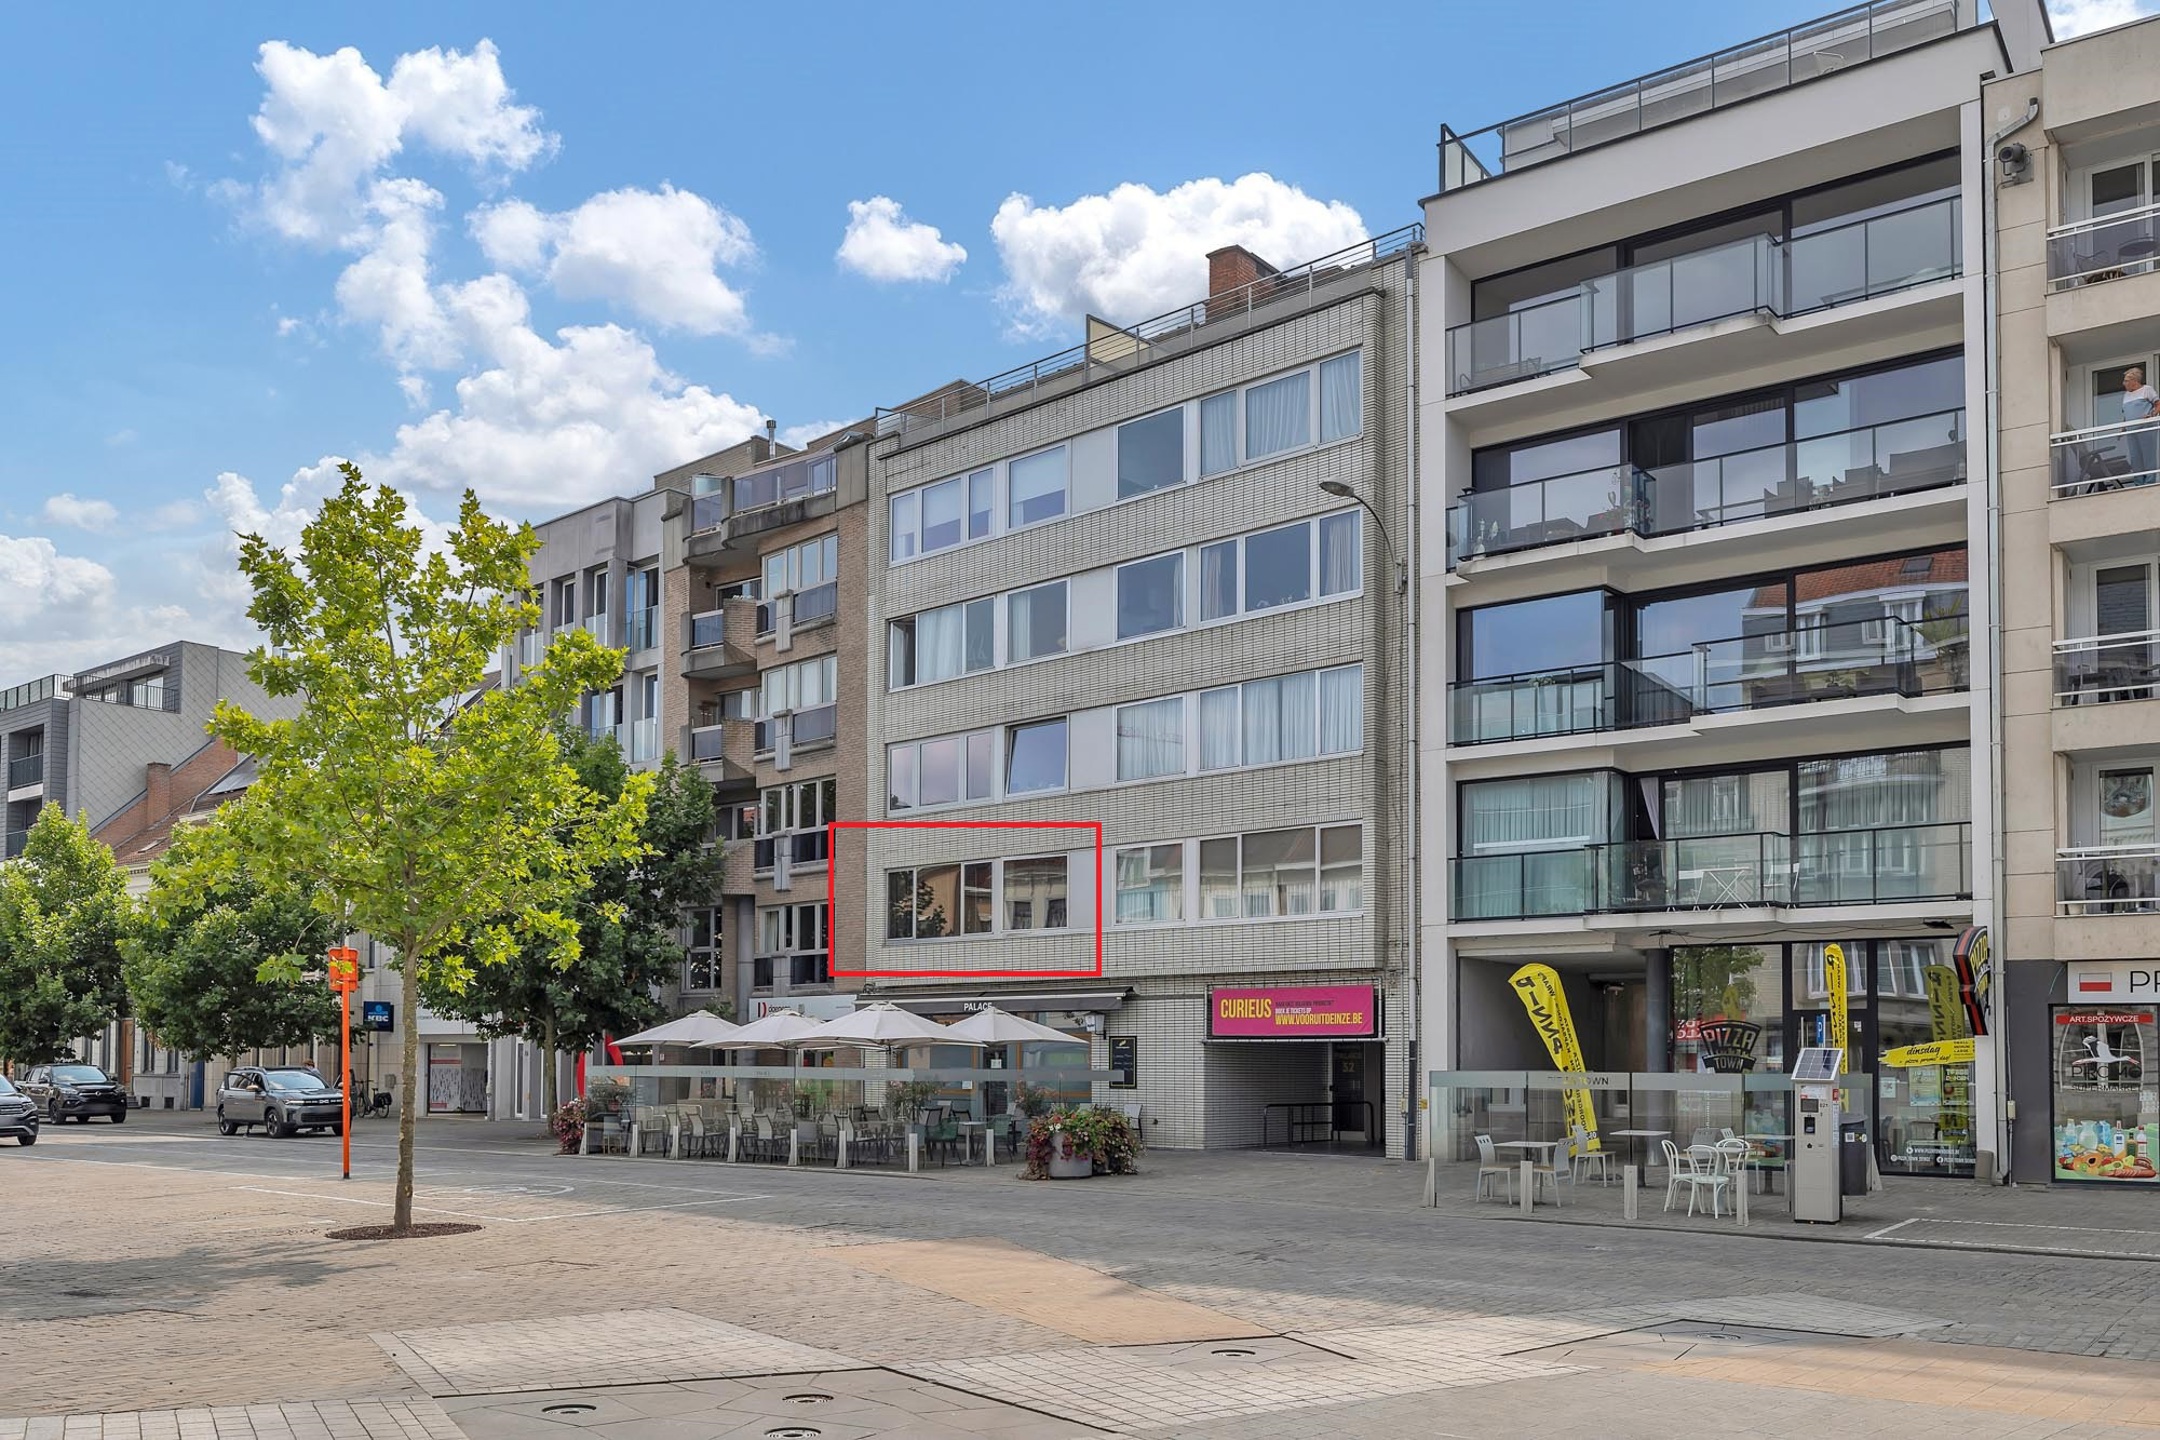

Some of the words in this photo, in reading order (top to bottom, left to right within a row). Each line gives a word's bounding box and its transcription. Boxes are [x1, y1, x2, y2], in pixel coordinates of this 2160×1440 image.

[2129, 970, 2160, 993] P
[963, 1001, 993, 1011] PALACE
[1220, 998, 1272, 1019] CURIEUS
[367, 1014, 389, 1022] KBC
[2068, 1014, 2140, 1023] ART.SPOŻYWCZE
[1703, 1027, 1757, 1056] PIZZA
[1714, 1056, 1744, 1070] TOWN
